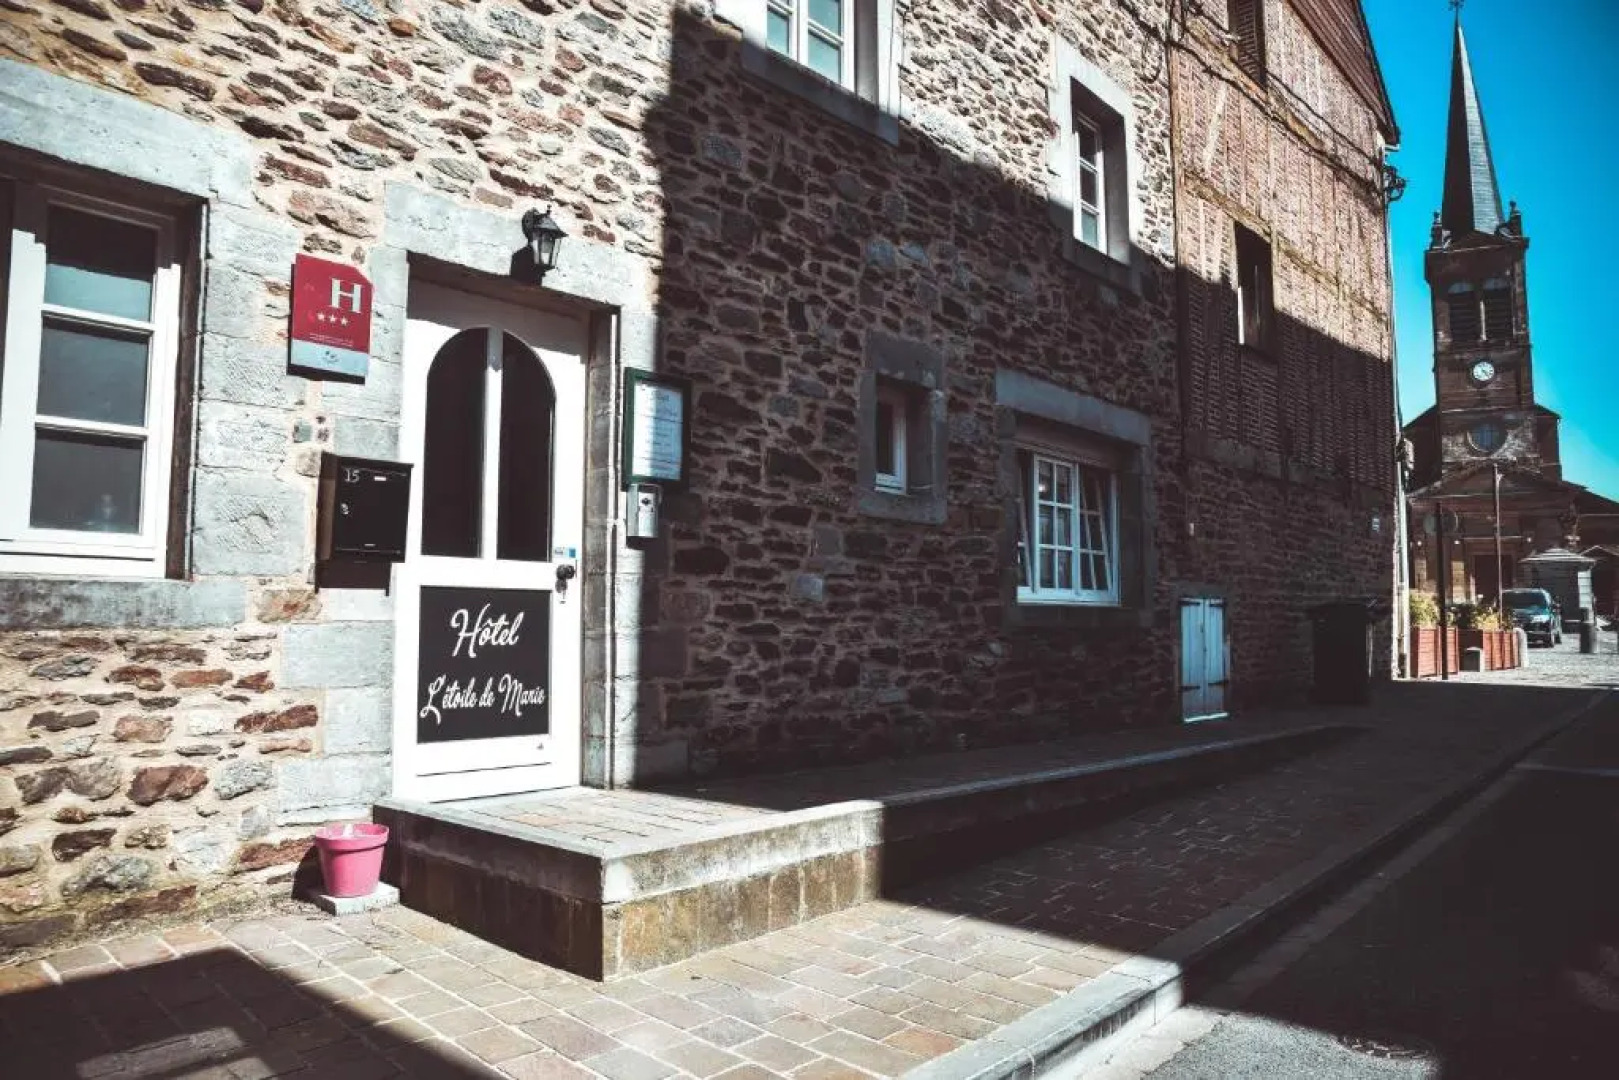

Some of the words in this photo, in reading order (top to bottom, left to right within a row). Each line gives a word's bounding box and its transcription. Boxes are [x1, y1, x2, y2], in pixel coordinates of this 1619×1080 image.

[329, 277, 363, 314] H
[344, 467, 360, 482] 15
[450, 603, 524, 658] Hôtel
[478, 676, 495, 707] de
[498, 673, 545, 717] Marie
